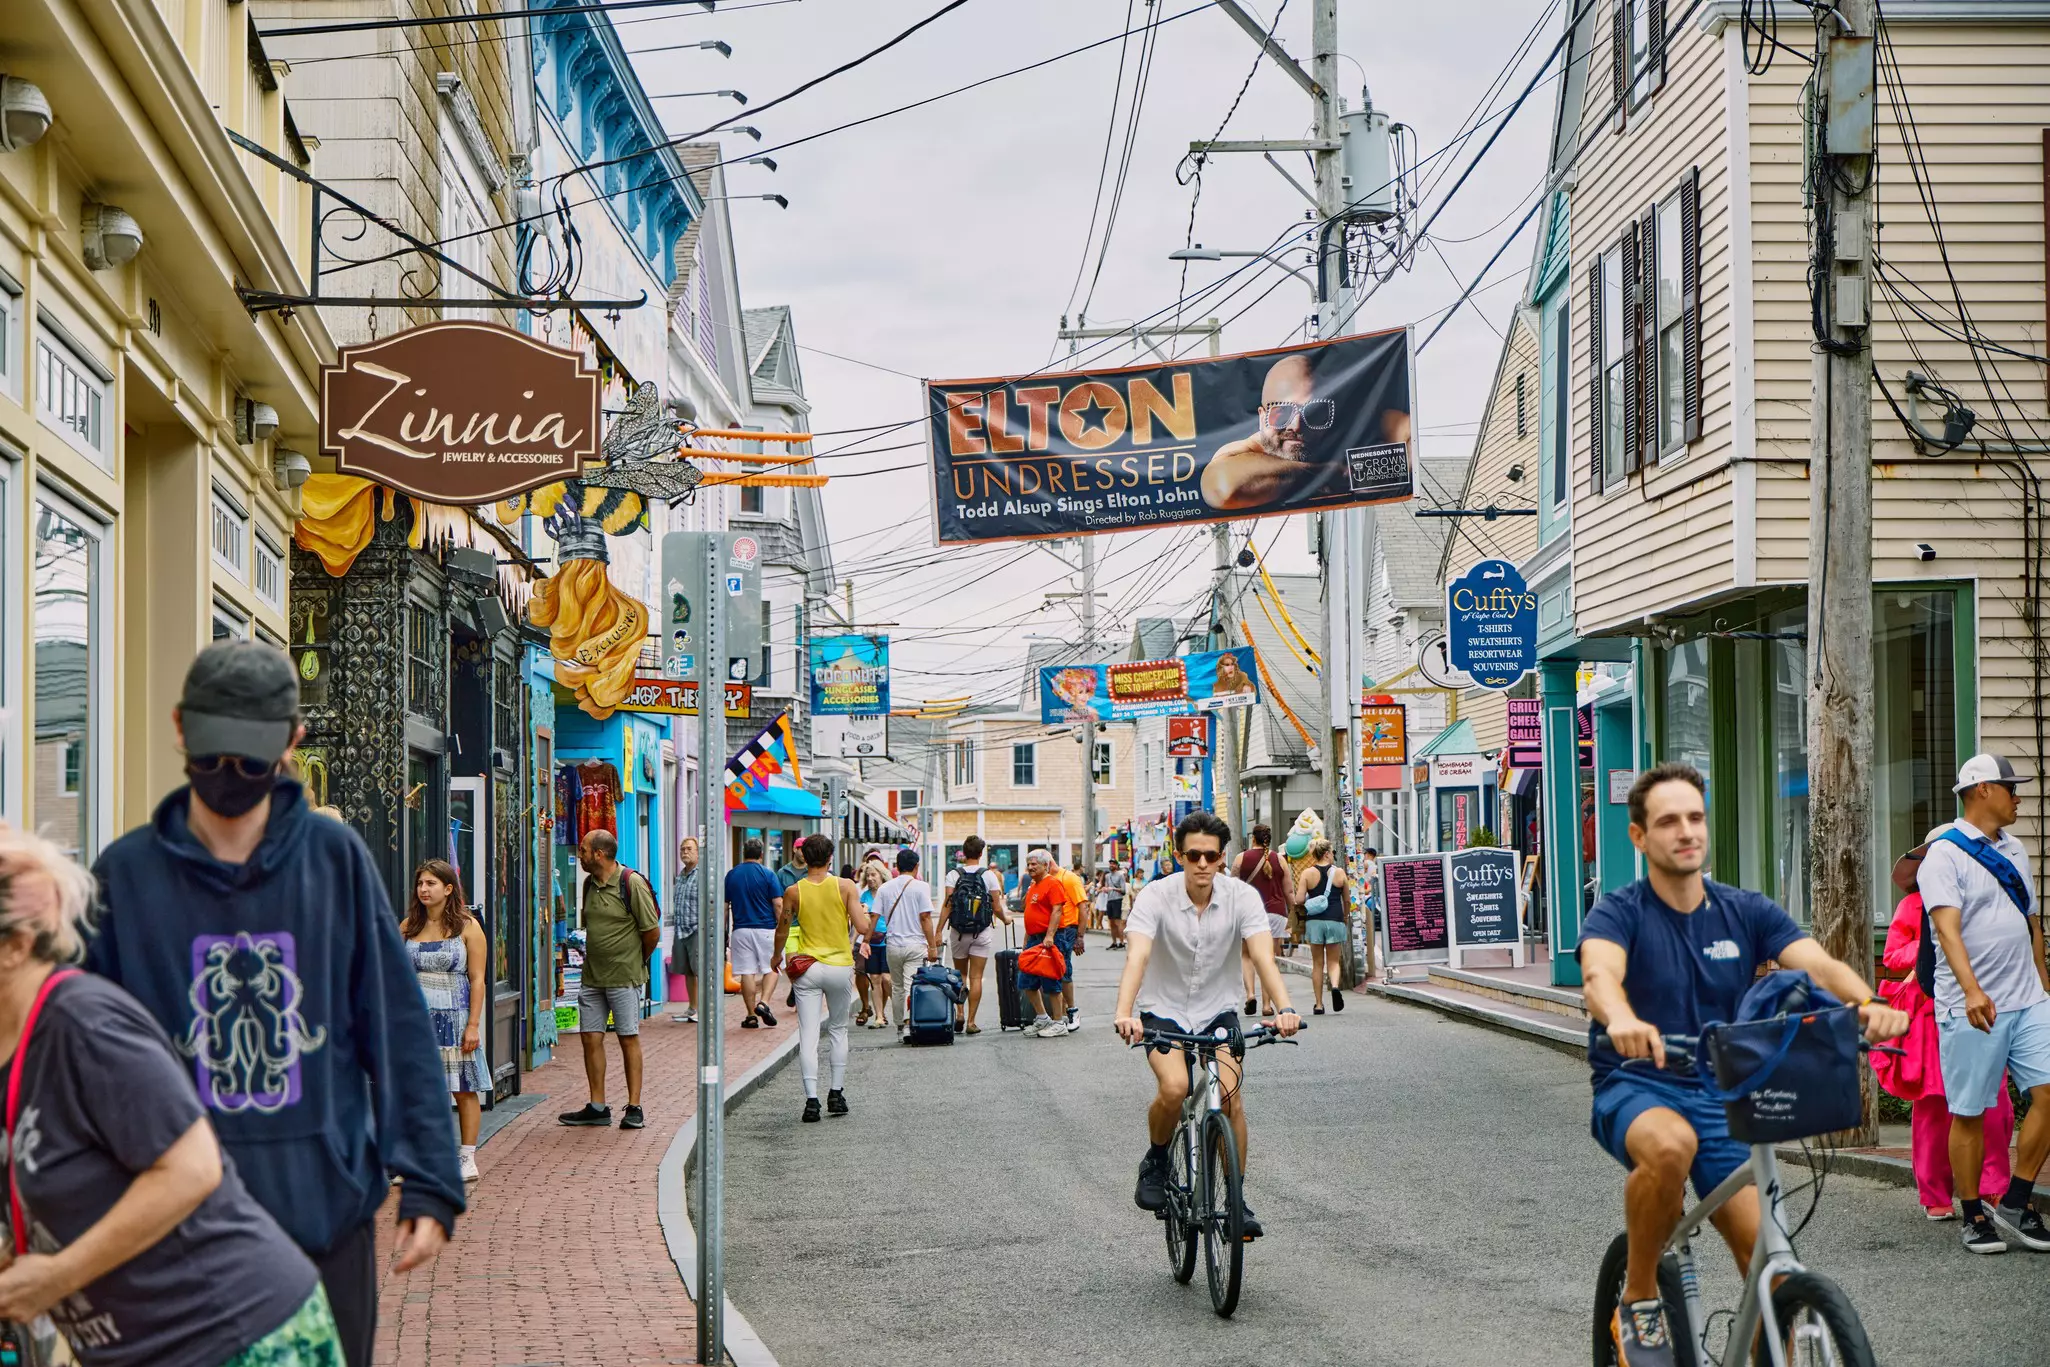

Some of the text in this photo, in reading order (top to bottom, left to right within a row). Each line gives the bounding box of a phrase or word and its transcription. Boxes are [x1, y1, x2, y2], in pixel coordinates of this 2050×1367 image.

[338, 361, 583, 459] Zinnia
[946, 372, 1196, 456] ELTON
[442, 452, 564, 465] JEWELRY & ACCESSORIES
[1351, 449, 1392, 460] WEDNESDAYS
[1364, 455, 1406, 468] CROWN
[1366, 463, 1407, 476] ANCHOR
[954, 453, 1196, 500] UNDRESSED
[1366, 472, 1408, 481] PROVINCETOWN
[957, 486, 1200, 520] Todd Alsup Sings Elton John
[1085, 506, 1202, 526] Directed by Rob Ruggiero
[1453, 587, 1537, 619] Cuffy's
[1461, 611, 1508, 621] of Cape Cod
[1477, 624, 1512, 633] T-SHIRTS
[1468, 636, 1522, 646] SWEATSHIRTS
[1468, 649, 1523, 659] RESORTWEAR
[1473, 662, 1519, 671] SOUVENIRS
[815, 665, 888, 686] COCONUTS
[1114, 667, 1179, 685] MISS CONCEPTION
[824, 685, 877, 695] SUNGLASSES
[1115, 679, 1180, 694] GOES TO THE MOVIES
[823, 695, 879, 705] ACCESSORIES
[1509, 715, 1541, 727] CHEES
[1509, 728, 1541, 740] GALLE
[1438, 761, 1473, 769] HOMEMADE
[730, 750, 779, 799] OPEN
[1453, 863, 1513, 886] Cuffy's
